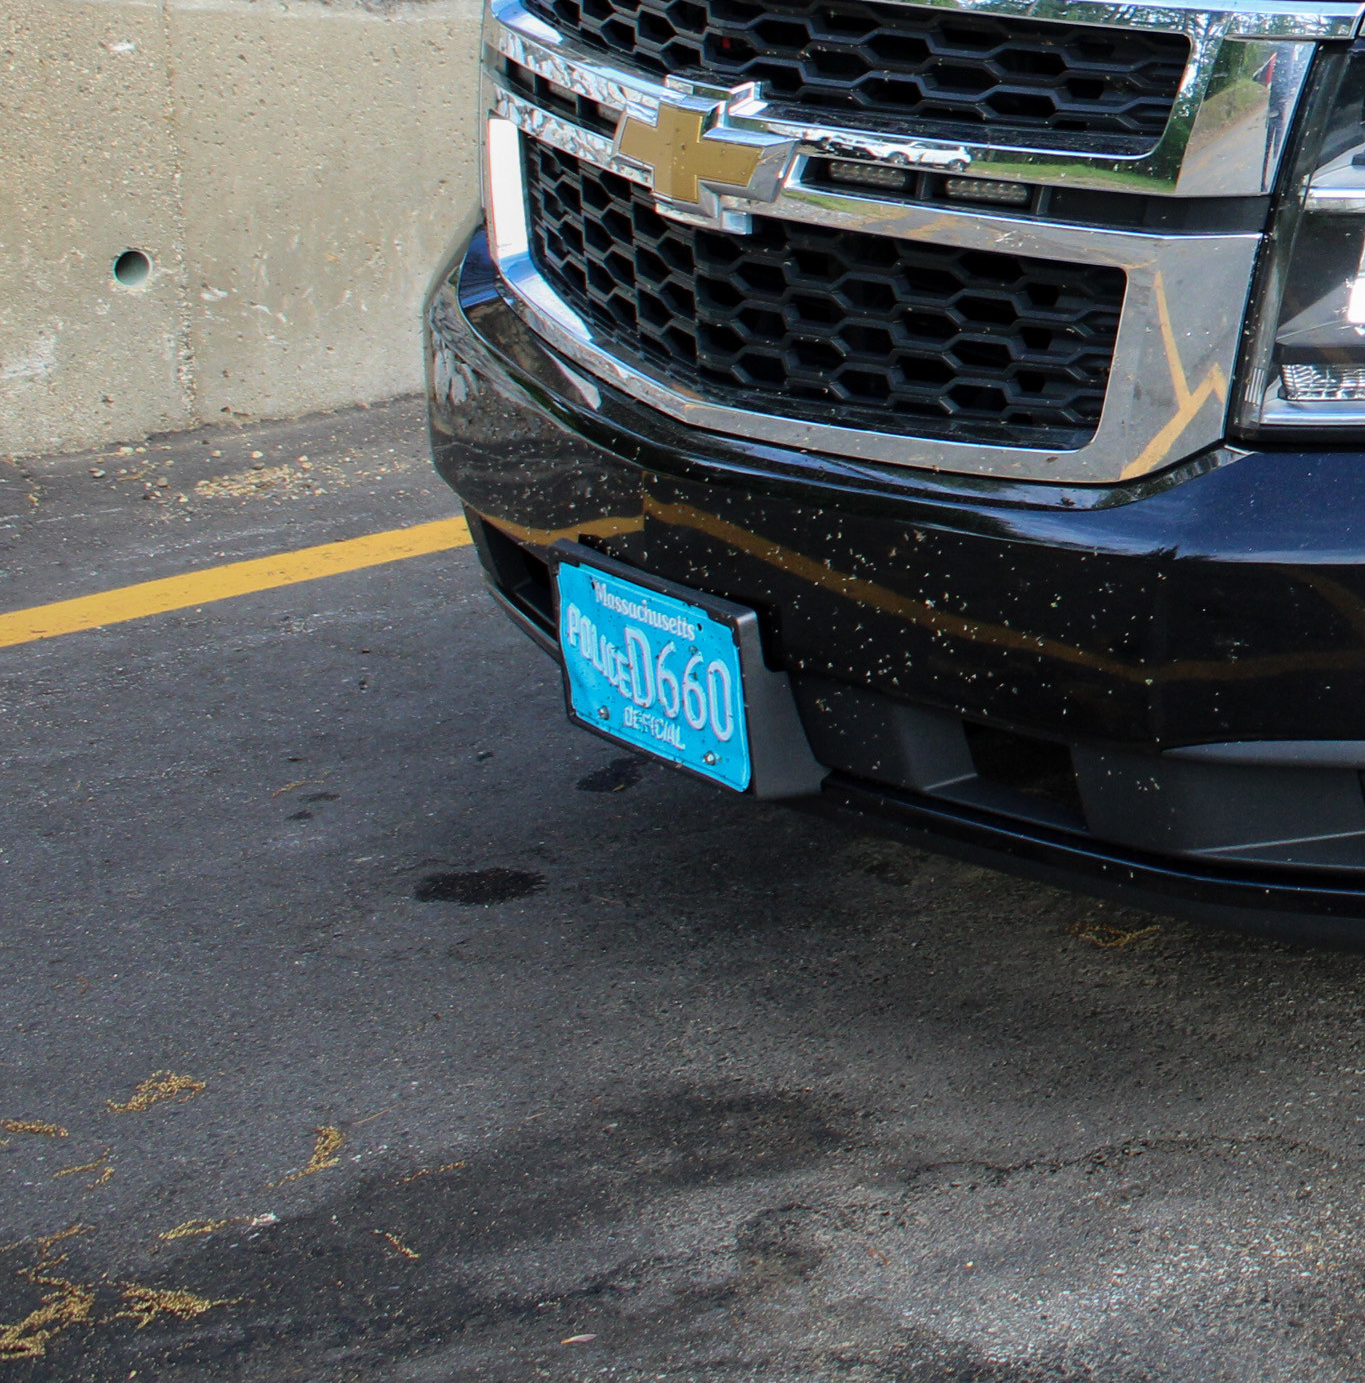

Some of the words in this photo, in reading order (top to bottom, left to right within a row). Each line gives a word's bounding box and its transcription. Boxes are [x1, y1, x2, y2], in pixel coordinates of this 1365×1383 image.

[592, 578, 696, 642] Massachusetts
[566, 602, 632, 700] POLICE
[624, 624, 734, 743] D660
[622, 705, 686, 751] OFFICIAL
